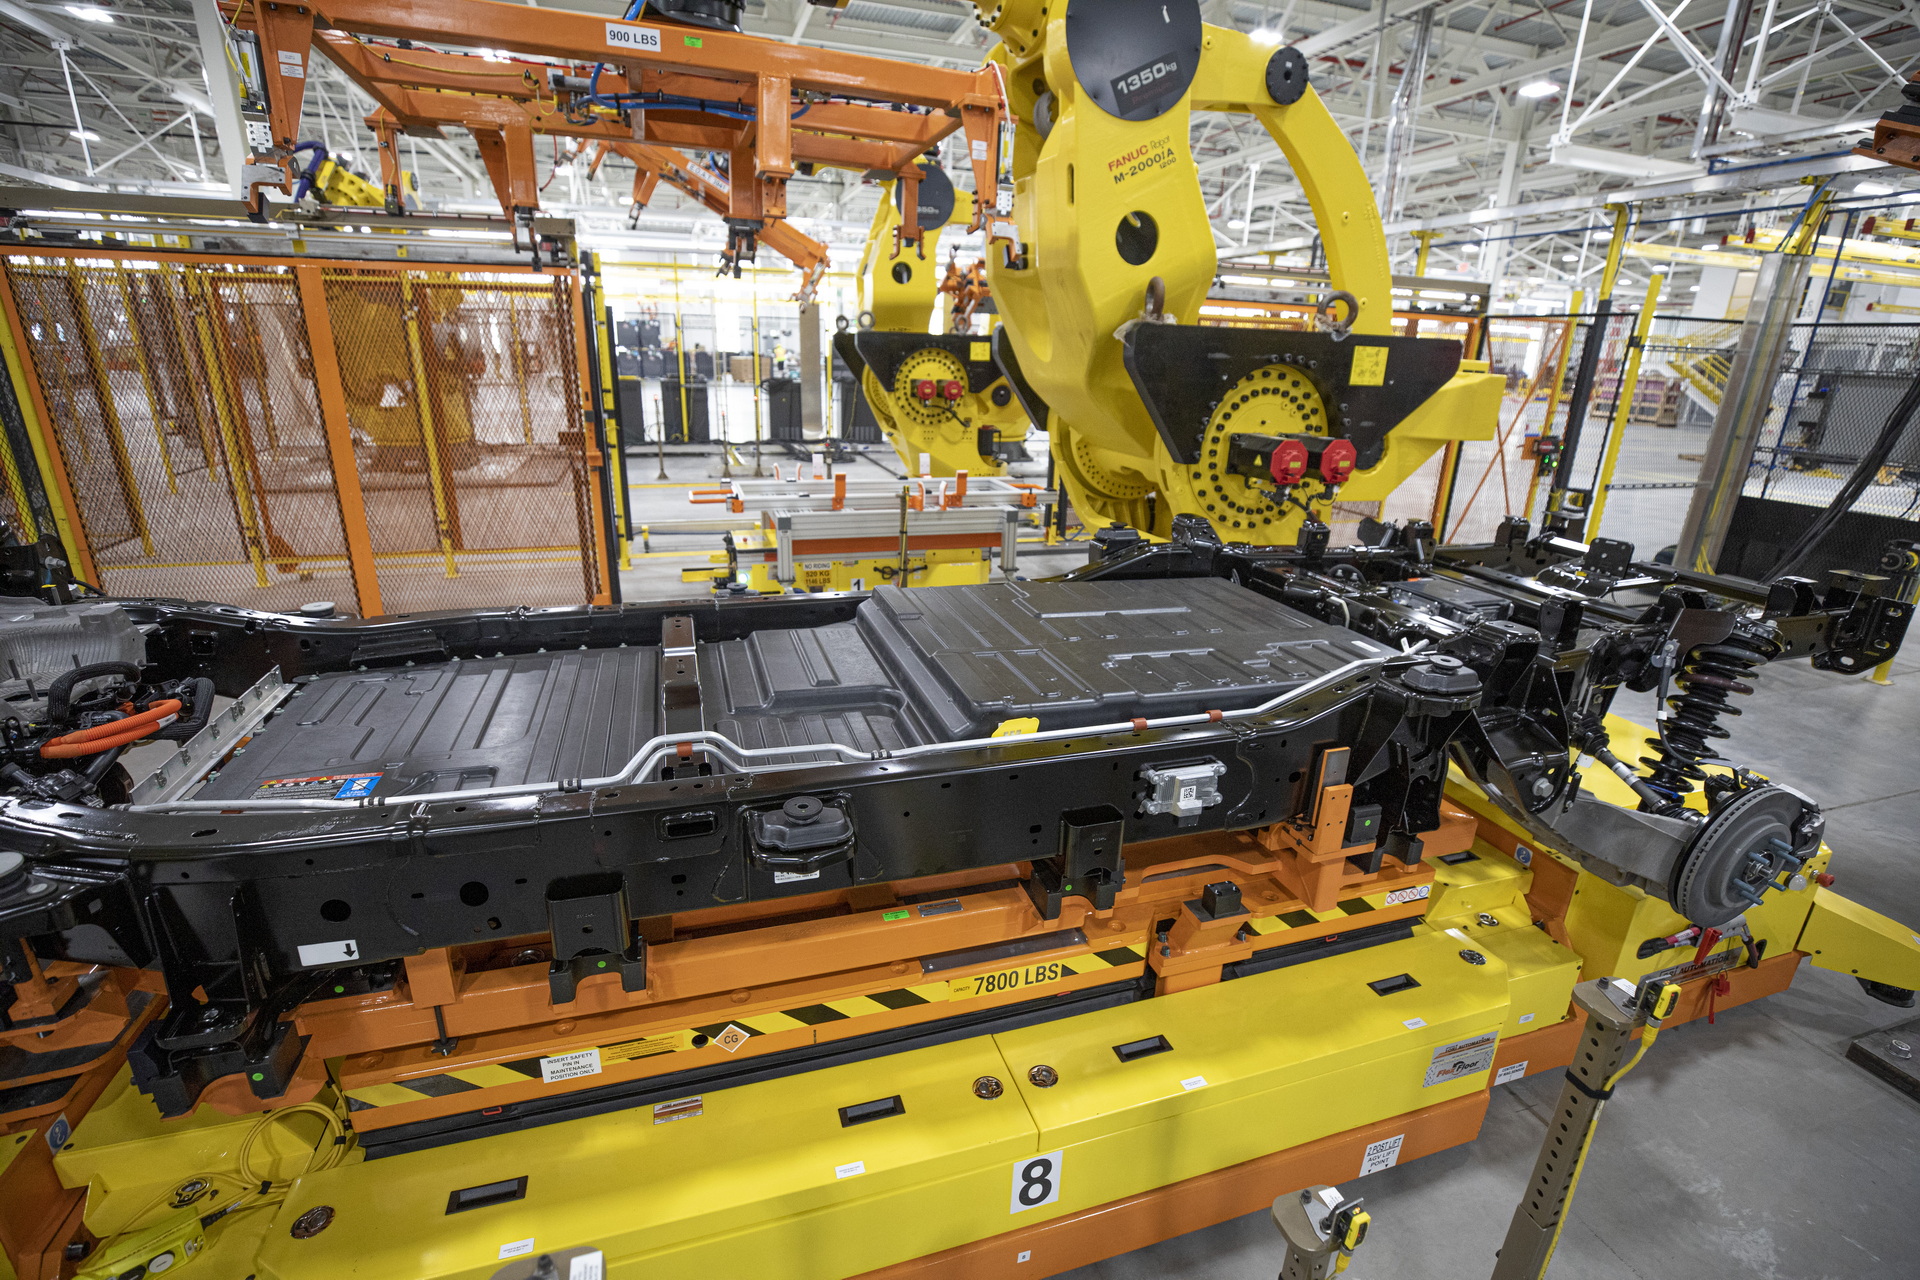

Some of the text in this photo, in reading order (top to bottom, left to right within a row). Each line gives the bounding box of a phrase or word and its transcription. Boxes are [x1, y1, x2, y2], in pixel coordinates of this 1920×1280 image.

[609, 30, 658, 46] 900 LBS
[1117, 61, 1178, 94] 1350kg
[1108, 144, 1149, 172] FANUC
[1159, 156, 1177, 169] 1200
[853, 578, 861, 591] 1
[973, 963, 1060, 996] 7800 LBS
[953, 985, 971, 993] CAPACITY
[724, 1034, 739, 1045] CG
[1458, 1036, 1491, 1049] AUTOMATION
[547, 1052, 593, 1064] INSERT SAFETY
[550, 1063, 594, 1075] MAINTENANCE
[550, 1068, 595, 1081] POSITION ONLY
[1367, 1137, 1402, 1157] 2 POST LIFT
[1367, 1150, 1396, 1163] AGV LIFT
[1370, 1157, 1390, 1167] POINT
[1018, 1158, 1053, 1207] 8
